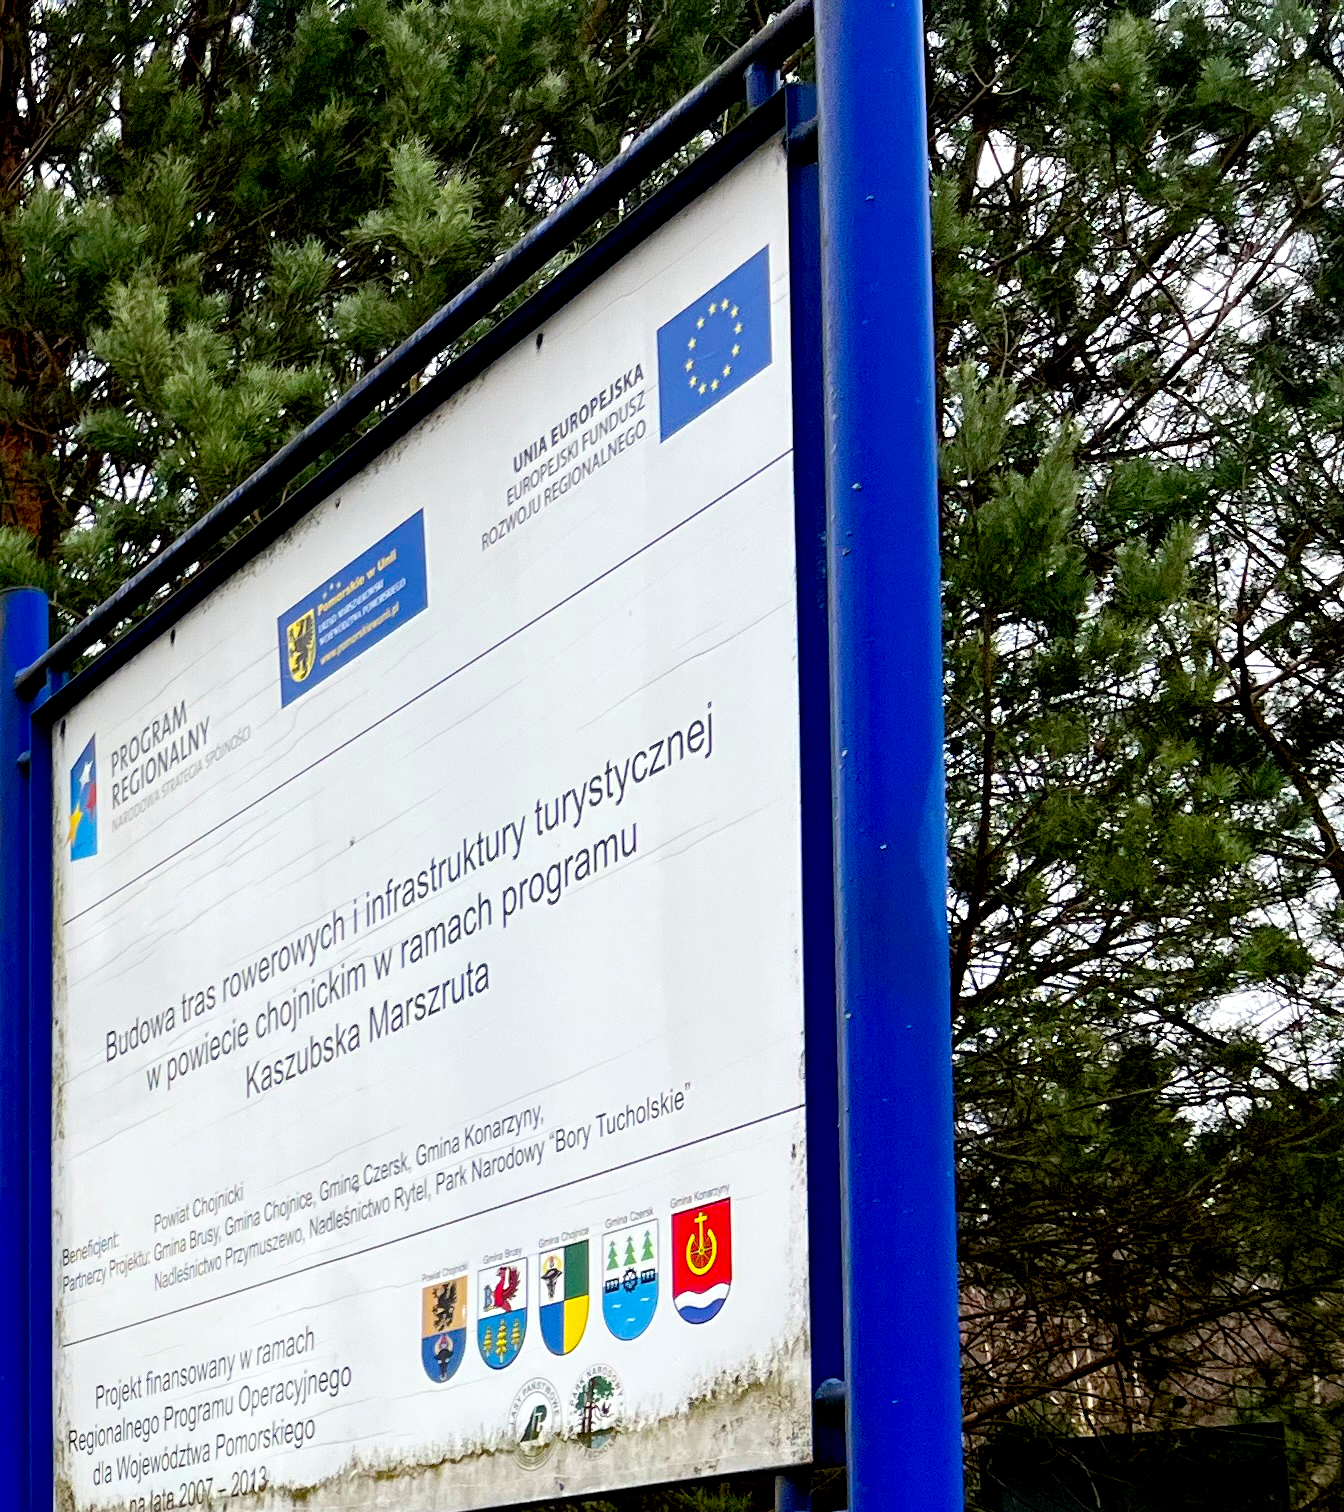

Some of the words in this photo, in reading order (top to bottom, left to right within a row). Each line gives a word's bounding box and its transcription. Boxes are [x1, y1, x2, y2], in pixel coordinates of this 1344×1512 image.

[506, 440, 579, 507] EUROPEJSKI
[582, 390, 646, 452] FUNDUSZ
[513, 434, 548, 474] UNIA
[551, 363, 644, 447] EUROPEJSKA
[481, 494, 541, 551] ROZWOJU
[544, 419, 647, 507] REGIONALNEGO
[318, 575, 365, 616] Pomorskie
[367, 567, 376, 580] w
[112, 700, 187, 778] PROGRAM
[112, 715, 210, 809] REGIONALNY
[112, 790, 160, 832] NARODOWA
[162, 760, 202, 799] STRATEGIA
[106, 1006, 175, 1063] Budowa
[182, 985, 216, 1023] tras
[223, 910, 345, 1003] rowerowych
[353, 899, 358, 934] i
[365, 815, 526, 928] infrastruktury
[534, 702, 713, 837] turystycznej
[146, 1064, 162, 1091] w
[167, 1018, 249, 1091] powiecie
[255, 962, 366, 1038] chojnickim
[374, 948, 392, 980] w
[400, 892, 492, 968] ramach
[502, 822, 638, 929] programu
[246, 1022, 361, 1099] Kaszubska
[369, 962, 489, 1042] Marszruta
[62, 1265, 106, 1294] Partnerzy
[109, 1251, 151, 1279] Projektu:
[154, 1238, 186, 1262] Gmina
[189, 1225, 222, 1250] Brusy,
[224, 1210, 261, 1236] Gmina
[264, 1190, 317, 1222] Chojnice,
[363, 1151, 411, 1186] Czersk,
[416, 1136, 460, 1166] Gmina
[464, 1105, 544, 1150] Konarzyny,
[154, 1204, 190, 1233] Powiat
[193, 1181, 244, 1218] Chojnicki
[154, 1256, 222, 1291] Nadleśnictwo
[225, 1226, 306, 1266] Przymuszewo,
[309, 1197, 390, 1239] Nadleśnictwo
[394, 1178, 431, 1212] Rytel,
[436, 1164, 468, 1195] Park
[471, 1140, 545, 1183] Narodowy
[605, 1214, 627, 1229] Gmina
[630, 1206, 654, 1222] Czersk
[670, 1194, 692, 1209] Gmina
[694, 1184, 730, 1200] Konarzyny
[483, 1253, 503, 1264] Gmina
[538, 1234, 559, 1248] Gmina
[95, 1374, 142, 1410] Projekt
[146, 1354, 237, 1396] finansowany
[239, 1349, 253, 1370] w
[256, 1325, 314, 1366] ramach
[68, 1414, 160, 1456] Regionalnego
[163, 1395, 234, 1431] Programu
[238, 1365, 352, 1416] Operacyjnego
[93, 1462, 113, 1486] dla
[116, 1440, 211, 1485] Województwa
[215, 1418, 316, 1460] Pomorskiego
[179, 1478, 214, 1508] 2007
[231, 1466, 268, 1497] 2013
